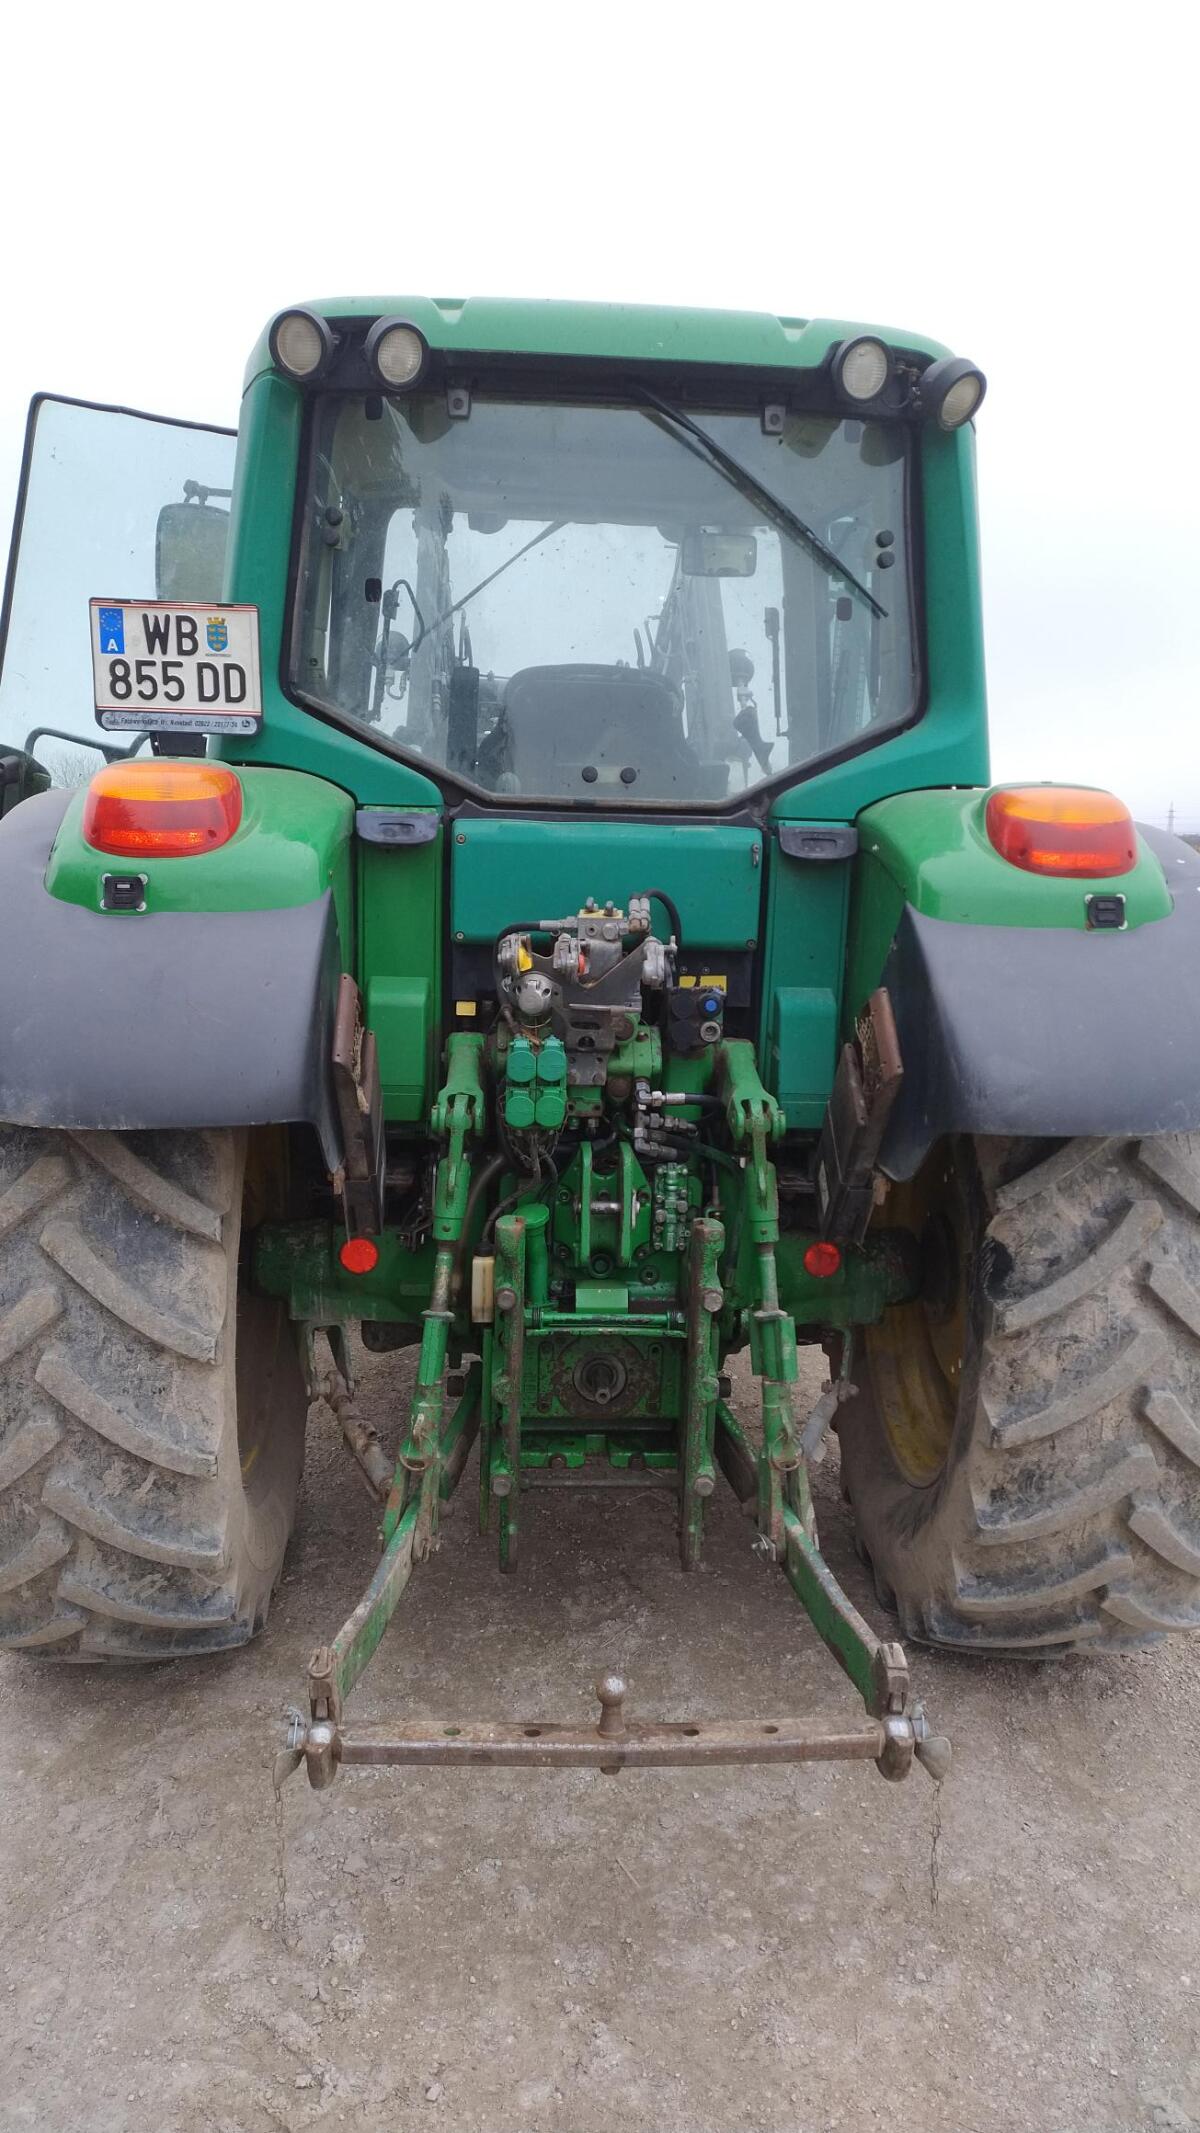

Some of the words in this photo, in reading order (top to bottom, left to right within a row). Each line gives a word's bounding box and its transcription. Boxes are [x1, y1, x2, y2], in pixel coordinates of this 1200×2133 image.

[107, 638, 119, 652] A
[142, 613, 198, 656] WB
[109, 658, 185, 701] 855
[197, 661, 247, 703] DD
